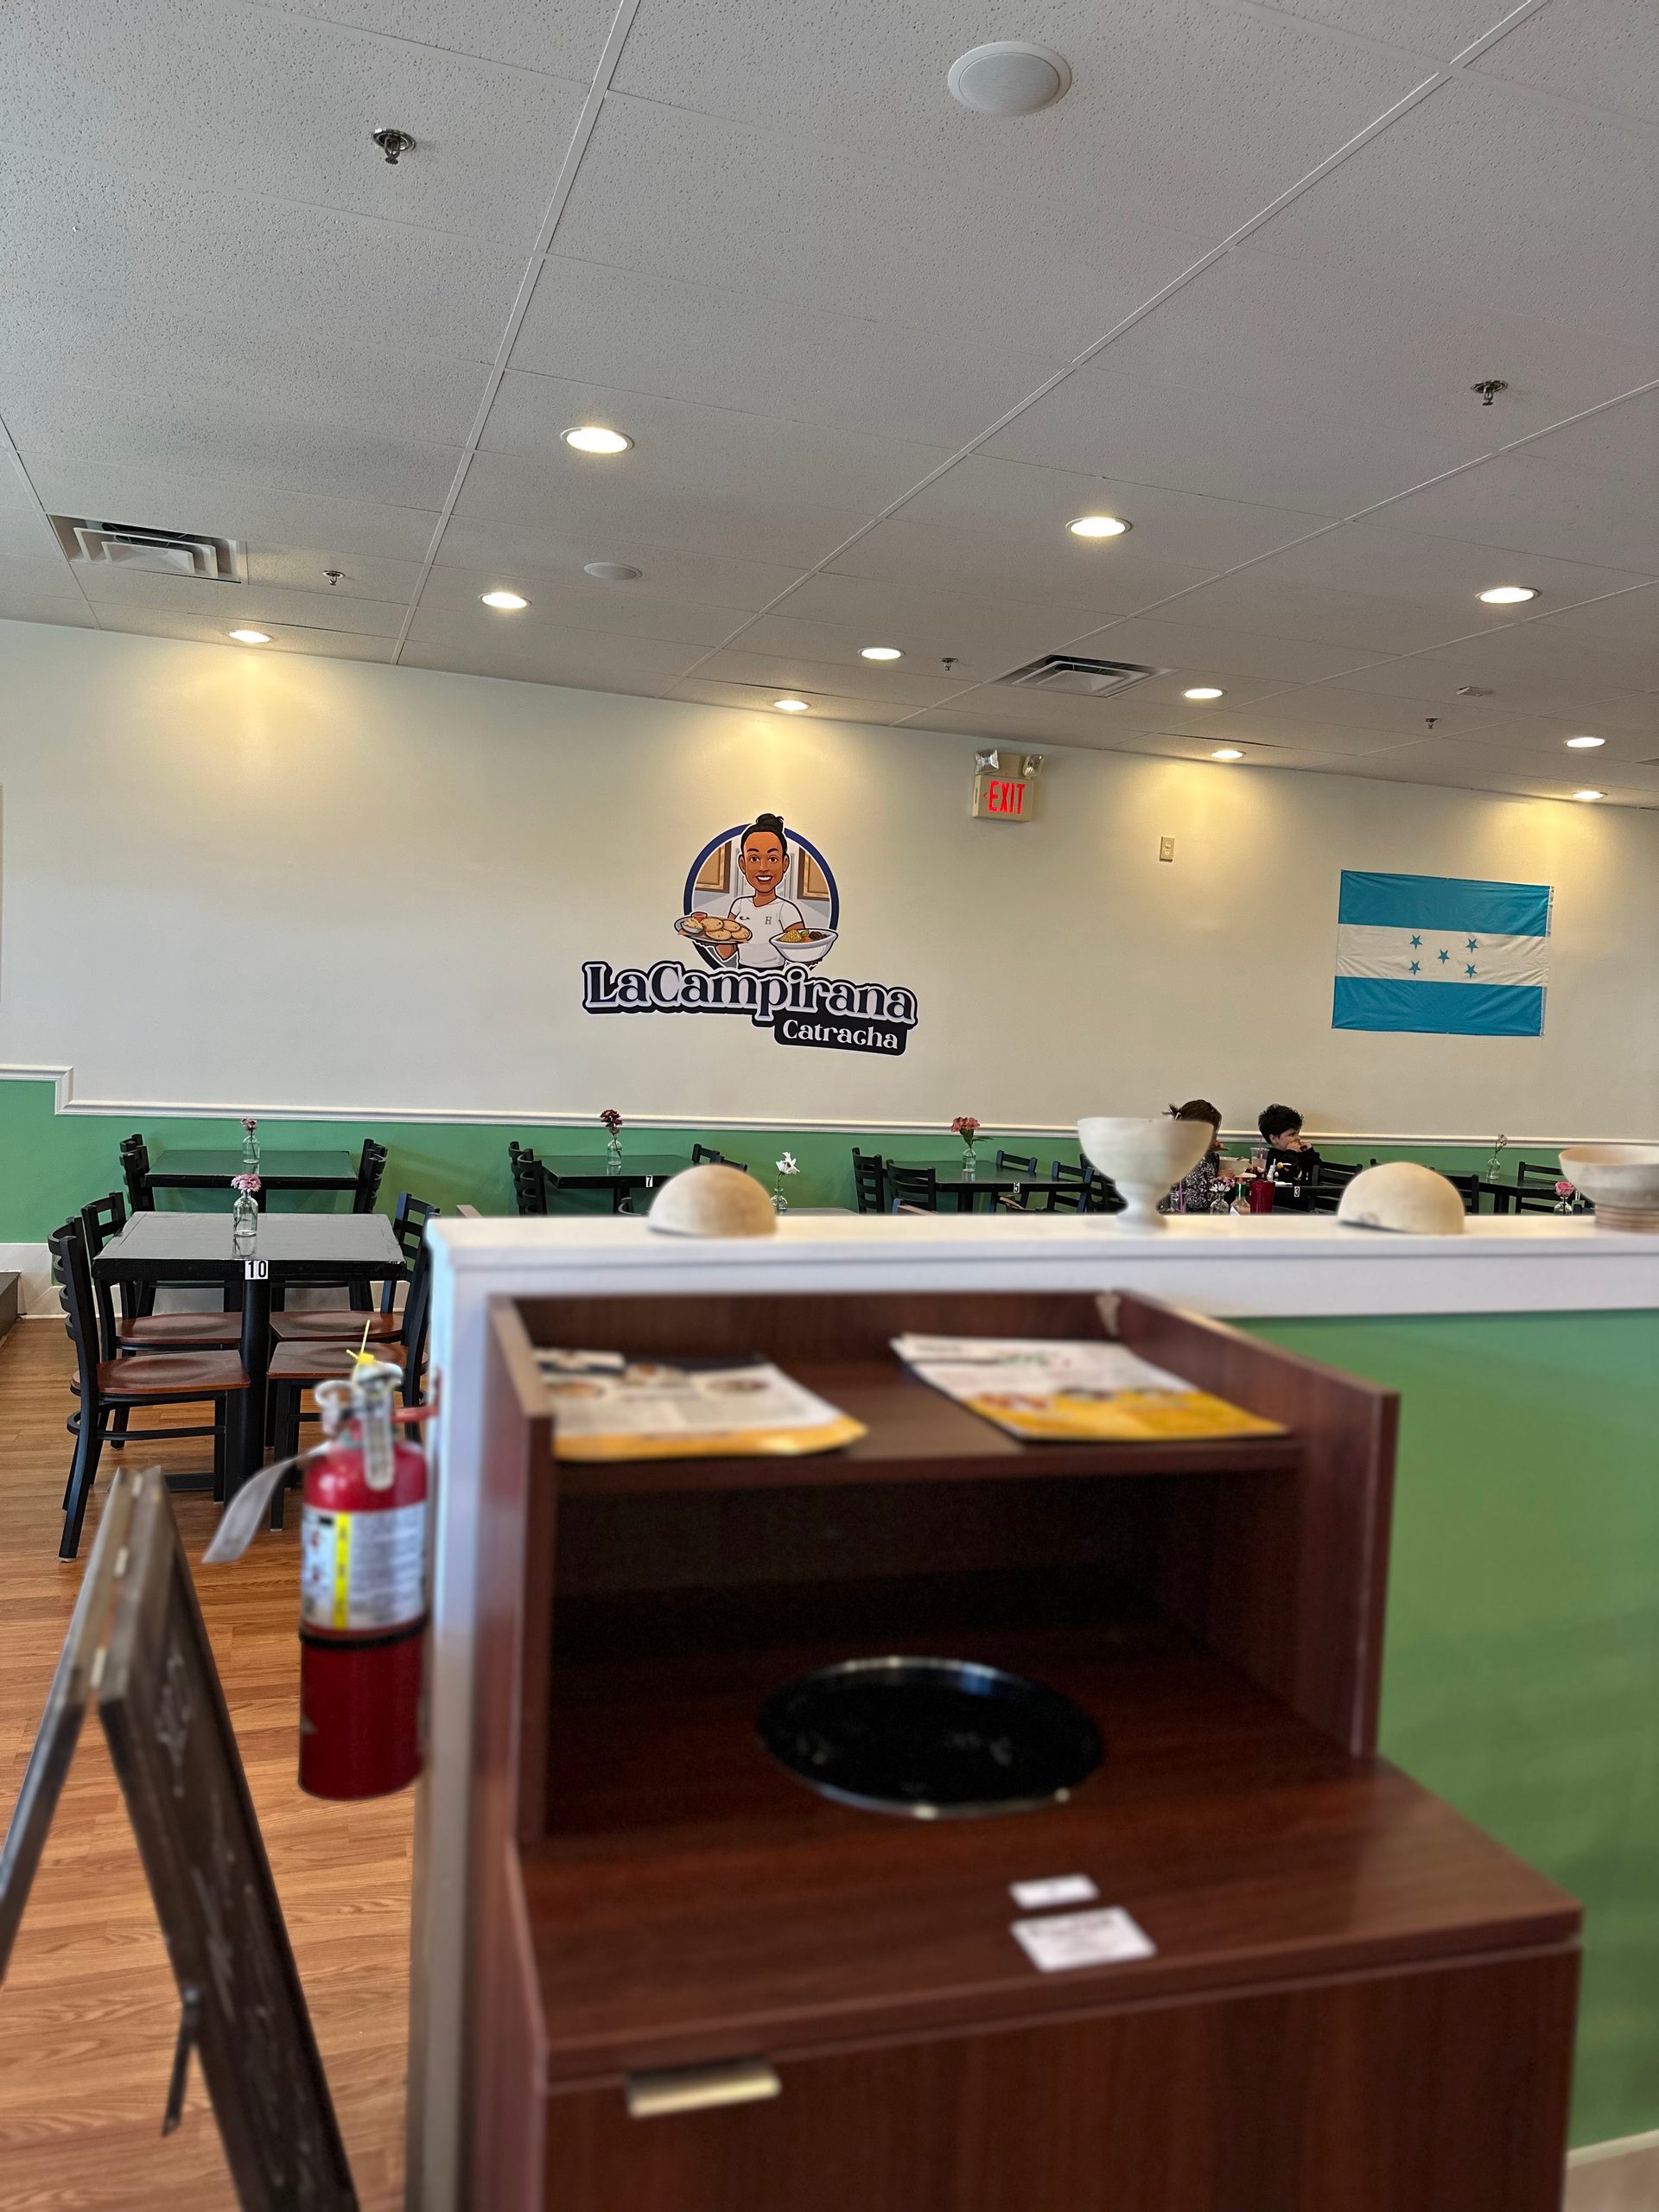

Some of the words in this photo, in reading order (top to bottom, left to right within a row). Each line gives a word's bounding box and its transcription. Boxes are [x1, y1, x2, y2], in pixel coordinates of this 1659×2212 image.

[988, 780, 1026, 814] EXIT
[783, 1020, 898, 1049] Catracha
[247, 1261, 267, 1278] 10
